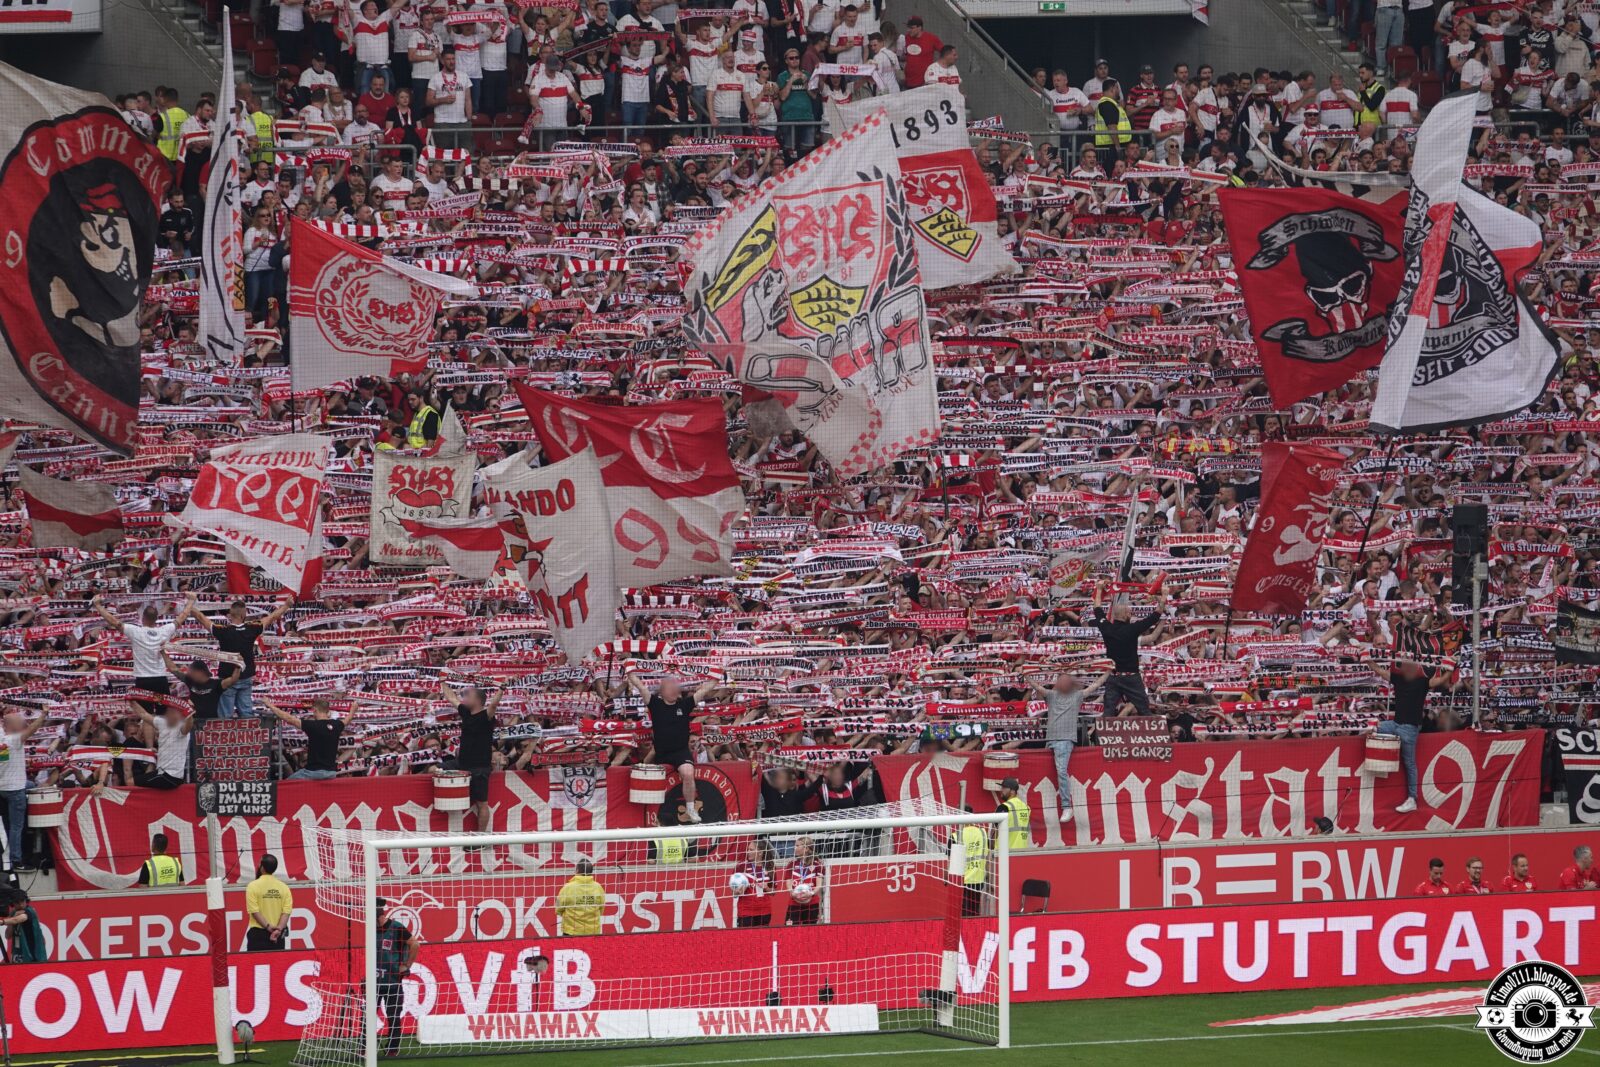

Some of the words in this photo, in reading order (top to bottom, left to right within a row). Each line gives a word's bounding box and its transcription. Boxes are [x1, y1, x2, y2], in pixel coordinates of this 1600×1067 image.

[1413, 359, 1454, 385] SEIT
[426, 544, 444, 559] Vf
[1501, 543, 1515, 551] VfB
[1517, 543, 1561, 553] STUTTGART
[1319, 610, 1344, 620] KSC
[291, 664, 312, 673] LIGA
[682, 665, 710, 676] ANDO
[886, 698, 914, 708] RAS
[937, 704, 1002, 714] Commando
[203, 719, 262, 731] JEDER
[507, 725, 535, 736] RAS
[889, 724, 919, 734] RAS
[1146, 720, 1167, 731] IST
[195, 730, 270, 744] VERBANNTE
[1099, 736, 1126, 746] DER
[1130, 735, 1170, 744] KAMPF
[1556, 729, 1600, 752] SC
[203, 745, 263, 757] KEHRT
[807, 751, 833, 760] ULT
[1103, 748, 1129, 759] UMS
[1131, 747, 1172, 759] GANZE
[566, 768, 595, 777] SSV
[219, 782, 240, 793] DU
[243, 782, 272, 793] BIST
[576, 778, 584, 793] R
[1423, 739, 1527, 834] 97
[219, 794, 273, 804] IMMER
[219, 805, 240, 814] BEI
[244, 804, 272, 815] UNS!
[160, 867, 174, 876] SDS
[886, 864, 916, 893] 35
[957, 926, 1090, 994] VfB
[1126, 905, 1596, 988] STUTTGART
[0, 967, 182, 1041] OW
[228, 960, 323, 1027] US
[467, 1012, 601, 1040] WINAMAX
[697, 1006, 831, 1035] WINAMAX
